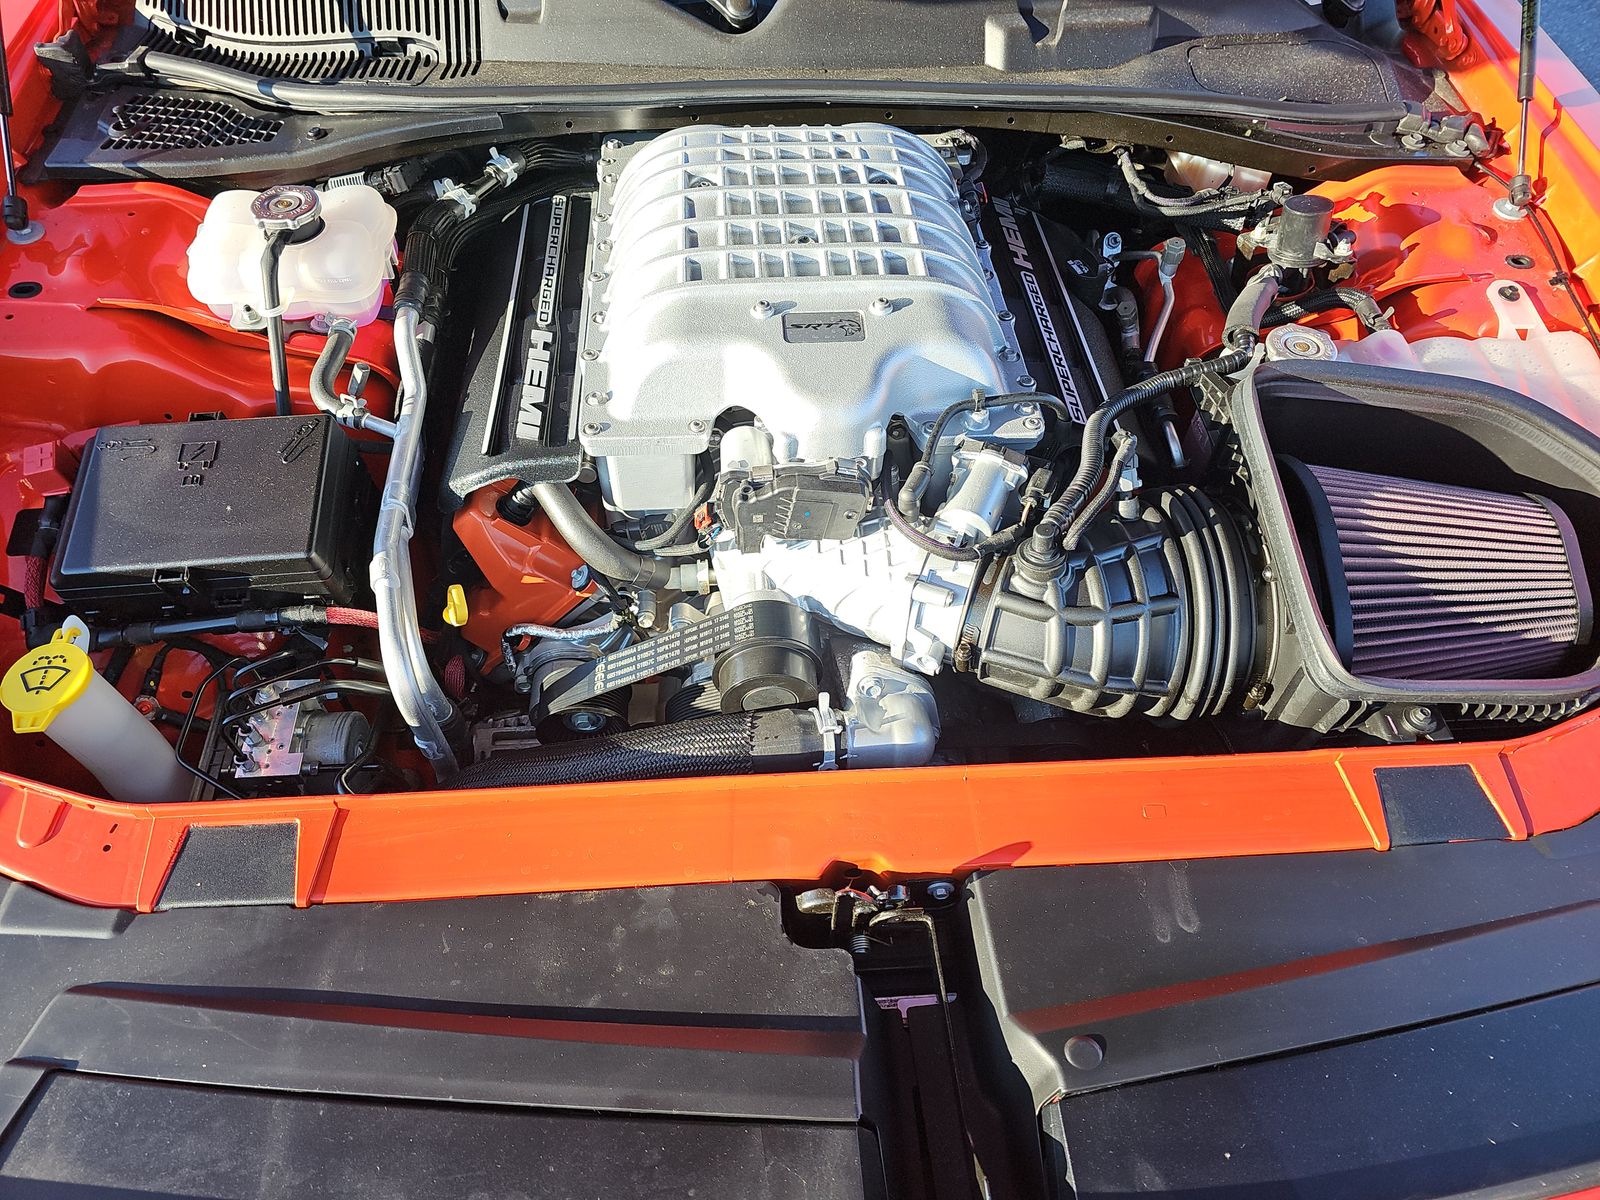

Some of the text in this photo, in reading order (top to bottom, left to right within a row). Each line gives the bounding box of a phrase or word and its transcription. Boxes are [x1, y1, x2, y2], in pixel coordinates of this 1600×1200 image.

[992, 196, 1033, 270] HEMI
[516, 197, 566, 441] SUPERCHARGED HEMI
[788, 322, 840, 331] SRT
[1022, 271, 1087, 424] SUPERCHARGED
[657, 631, 681, 644] 10PK1470
[656, 640, 681, 653] 10PK1470
[656, 649, 681, 662] 10PK1470
[656, 658, 681, 671] 10PK1470
